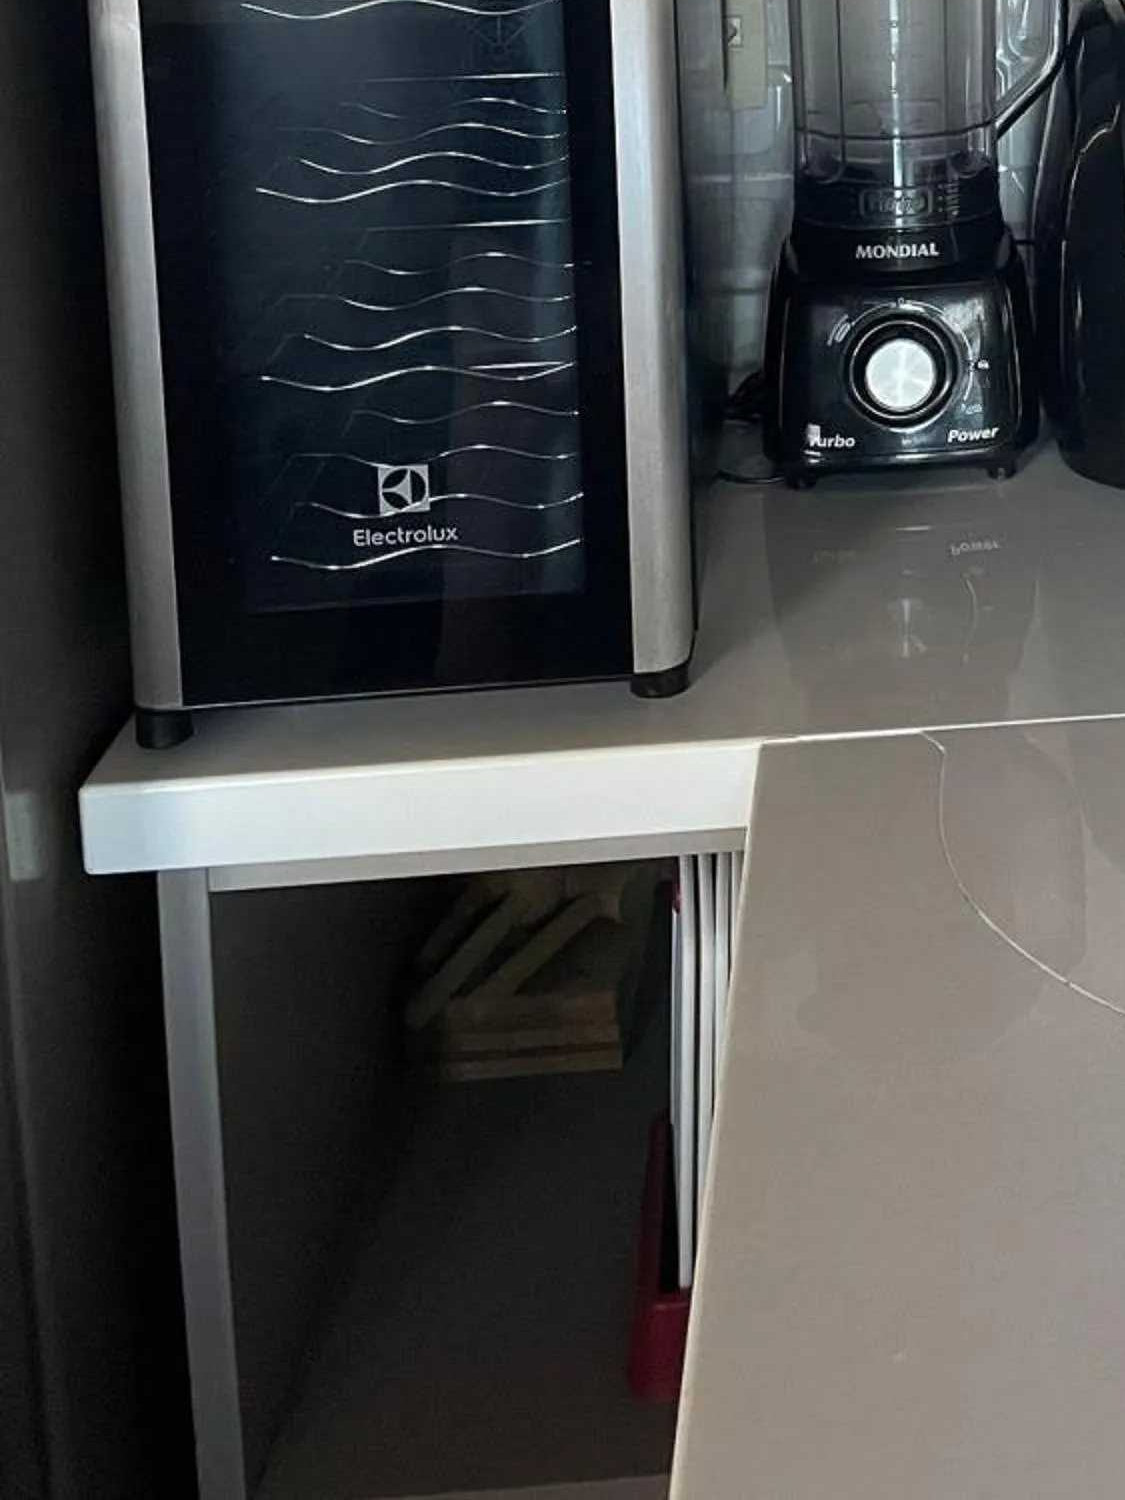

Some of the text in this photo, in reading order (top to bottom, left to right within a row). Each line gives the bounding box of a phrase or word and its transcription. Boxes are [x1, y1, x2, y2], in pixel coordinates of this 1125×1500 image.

[856, 242, 940, 259] MONDIAL
[947, 427, 1000, 443] Power
[352, 524, 459, 547] Electrolux
